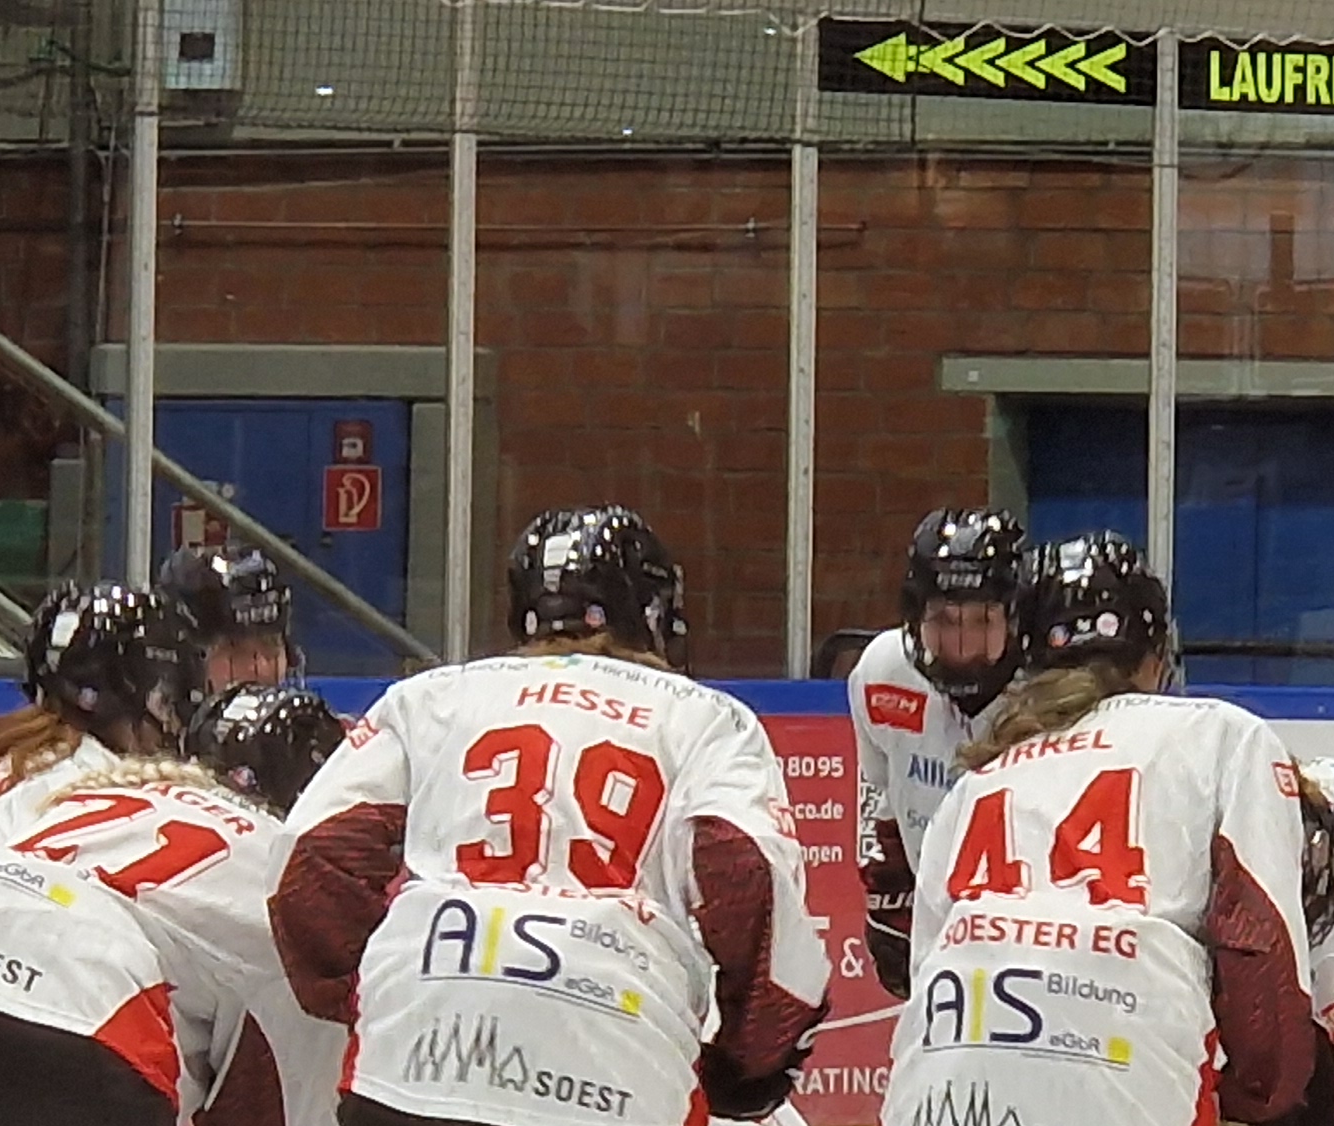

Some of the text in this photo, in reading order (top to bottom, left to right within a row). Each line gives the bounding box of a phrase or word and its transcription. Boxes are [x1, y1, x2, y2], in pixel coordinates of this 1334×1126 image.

[517, 682, 653, 730] HESSE
[456, 724, 665, 887] 39
[947, 767, 1148, 905] 44
[9, 793, 231, 900] 21
[421, 899, 567, 981] AIS
[840, 937, 864, 977] &
[939, 914, 1139, 958] SOESTER EG
[923, 968, 1138, 1046] AIS Bildung
[534, 1070, 633, 1117] SOEST
